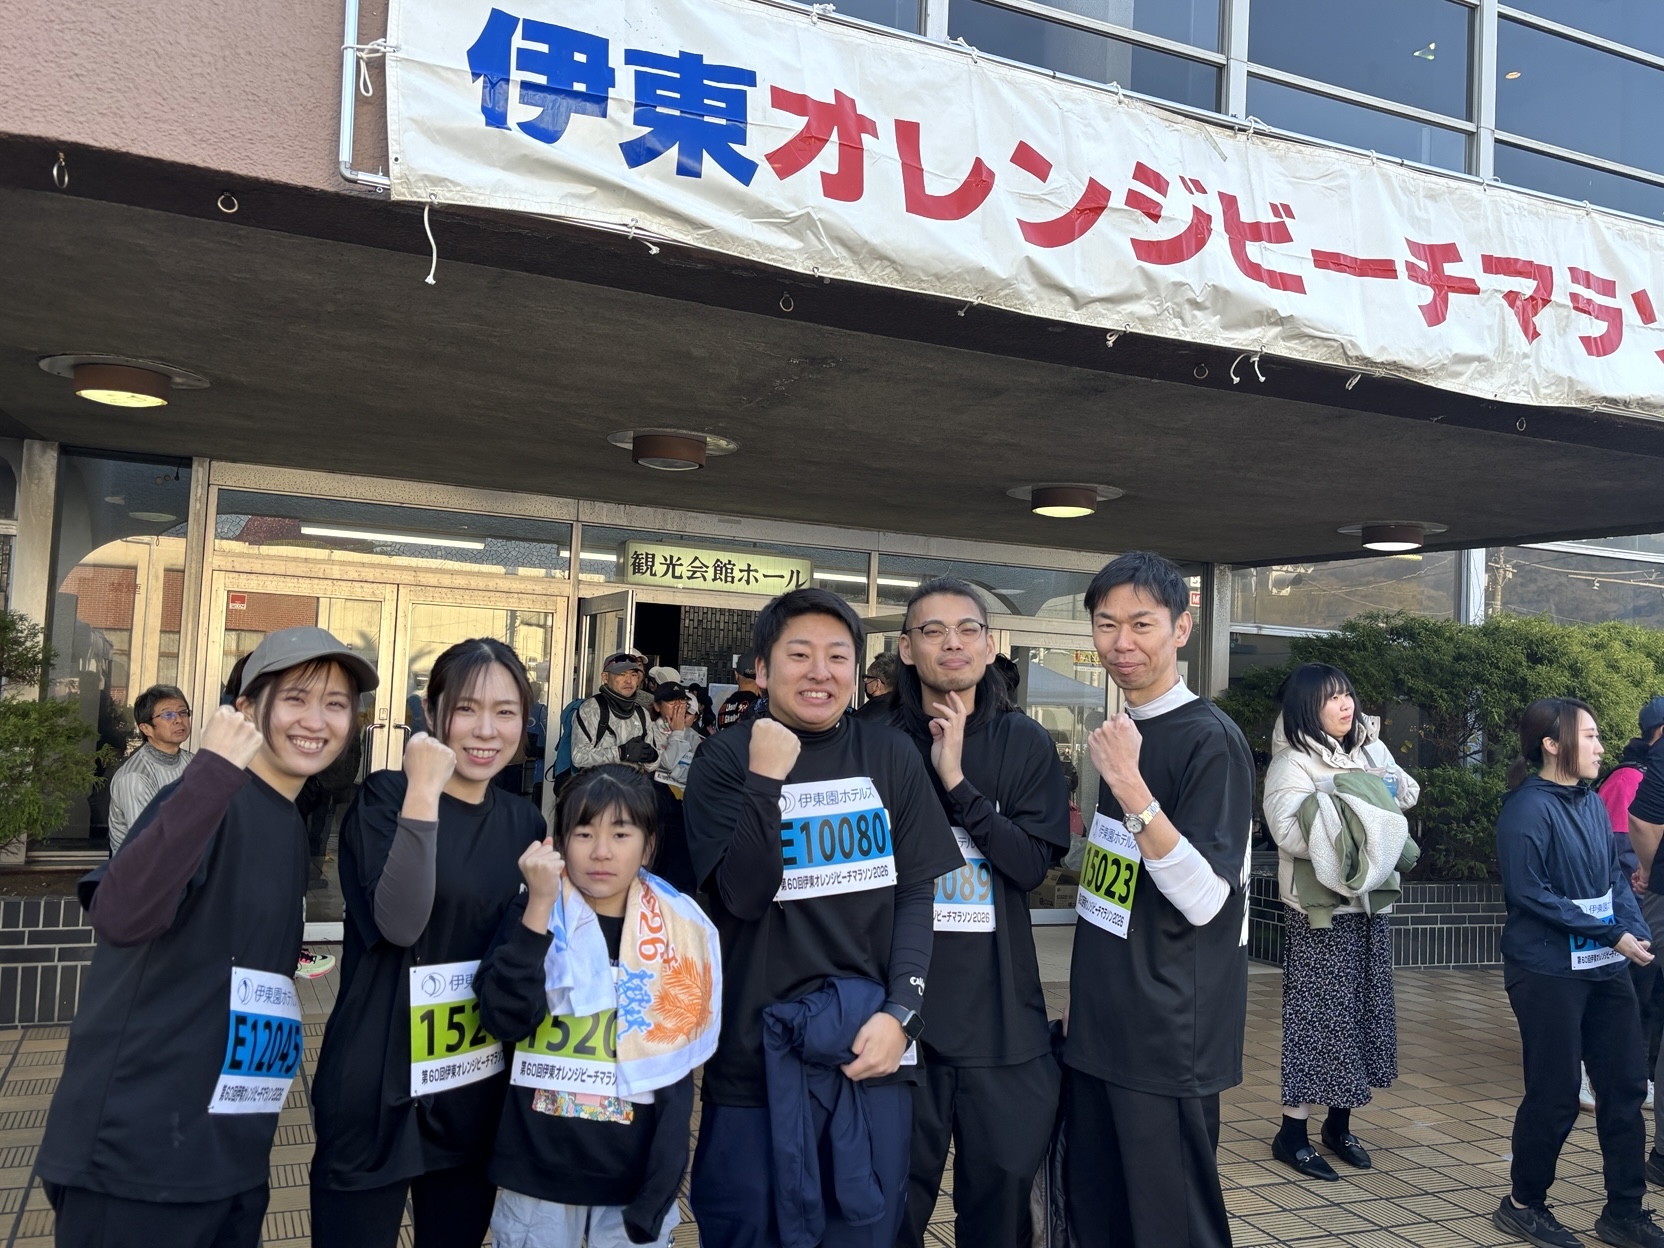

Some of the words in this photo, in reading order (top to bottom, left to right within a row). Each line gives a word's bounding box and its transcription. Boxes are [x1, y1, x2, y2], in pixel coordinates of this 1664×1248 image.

[630, 550, 808, 588] 観光会館ホール
[781, 812, 886, 865] E10080
[934, 862, 991, 901] 089
[1082, 847, 1134, 904] 15023
[228, 1015, 300, 1075] E12045
